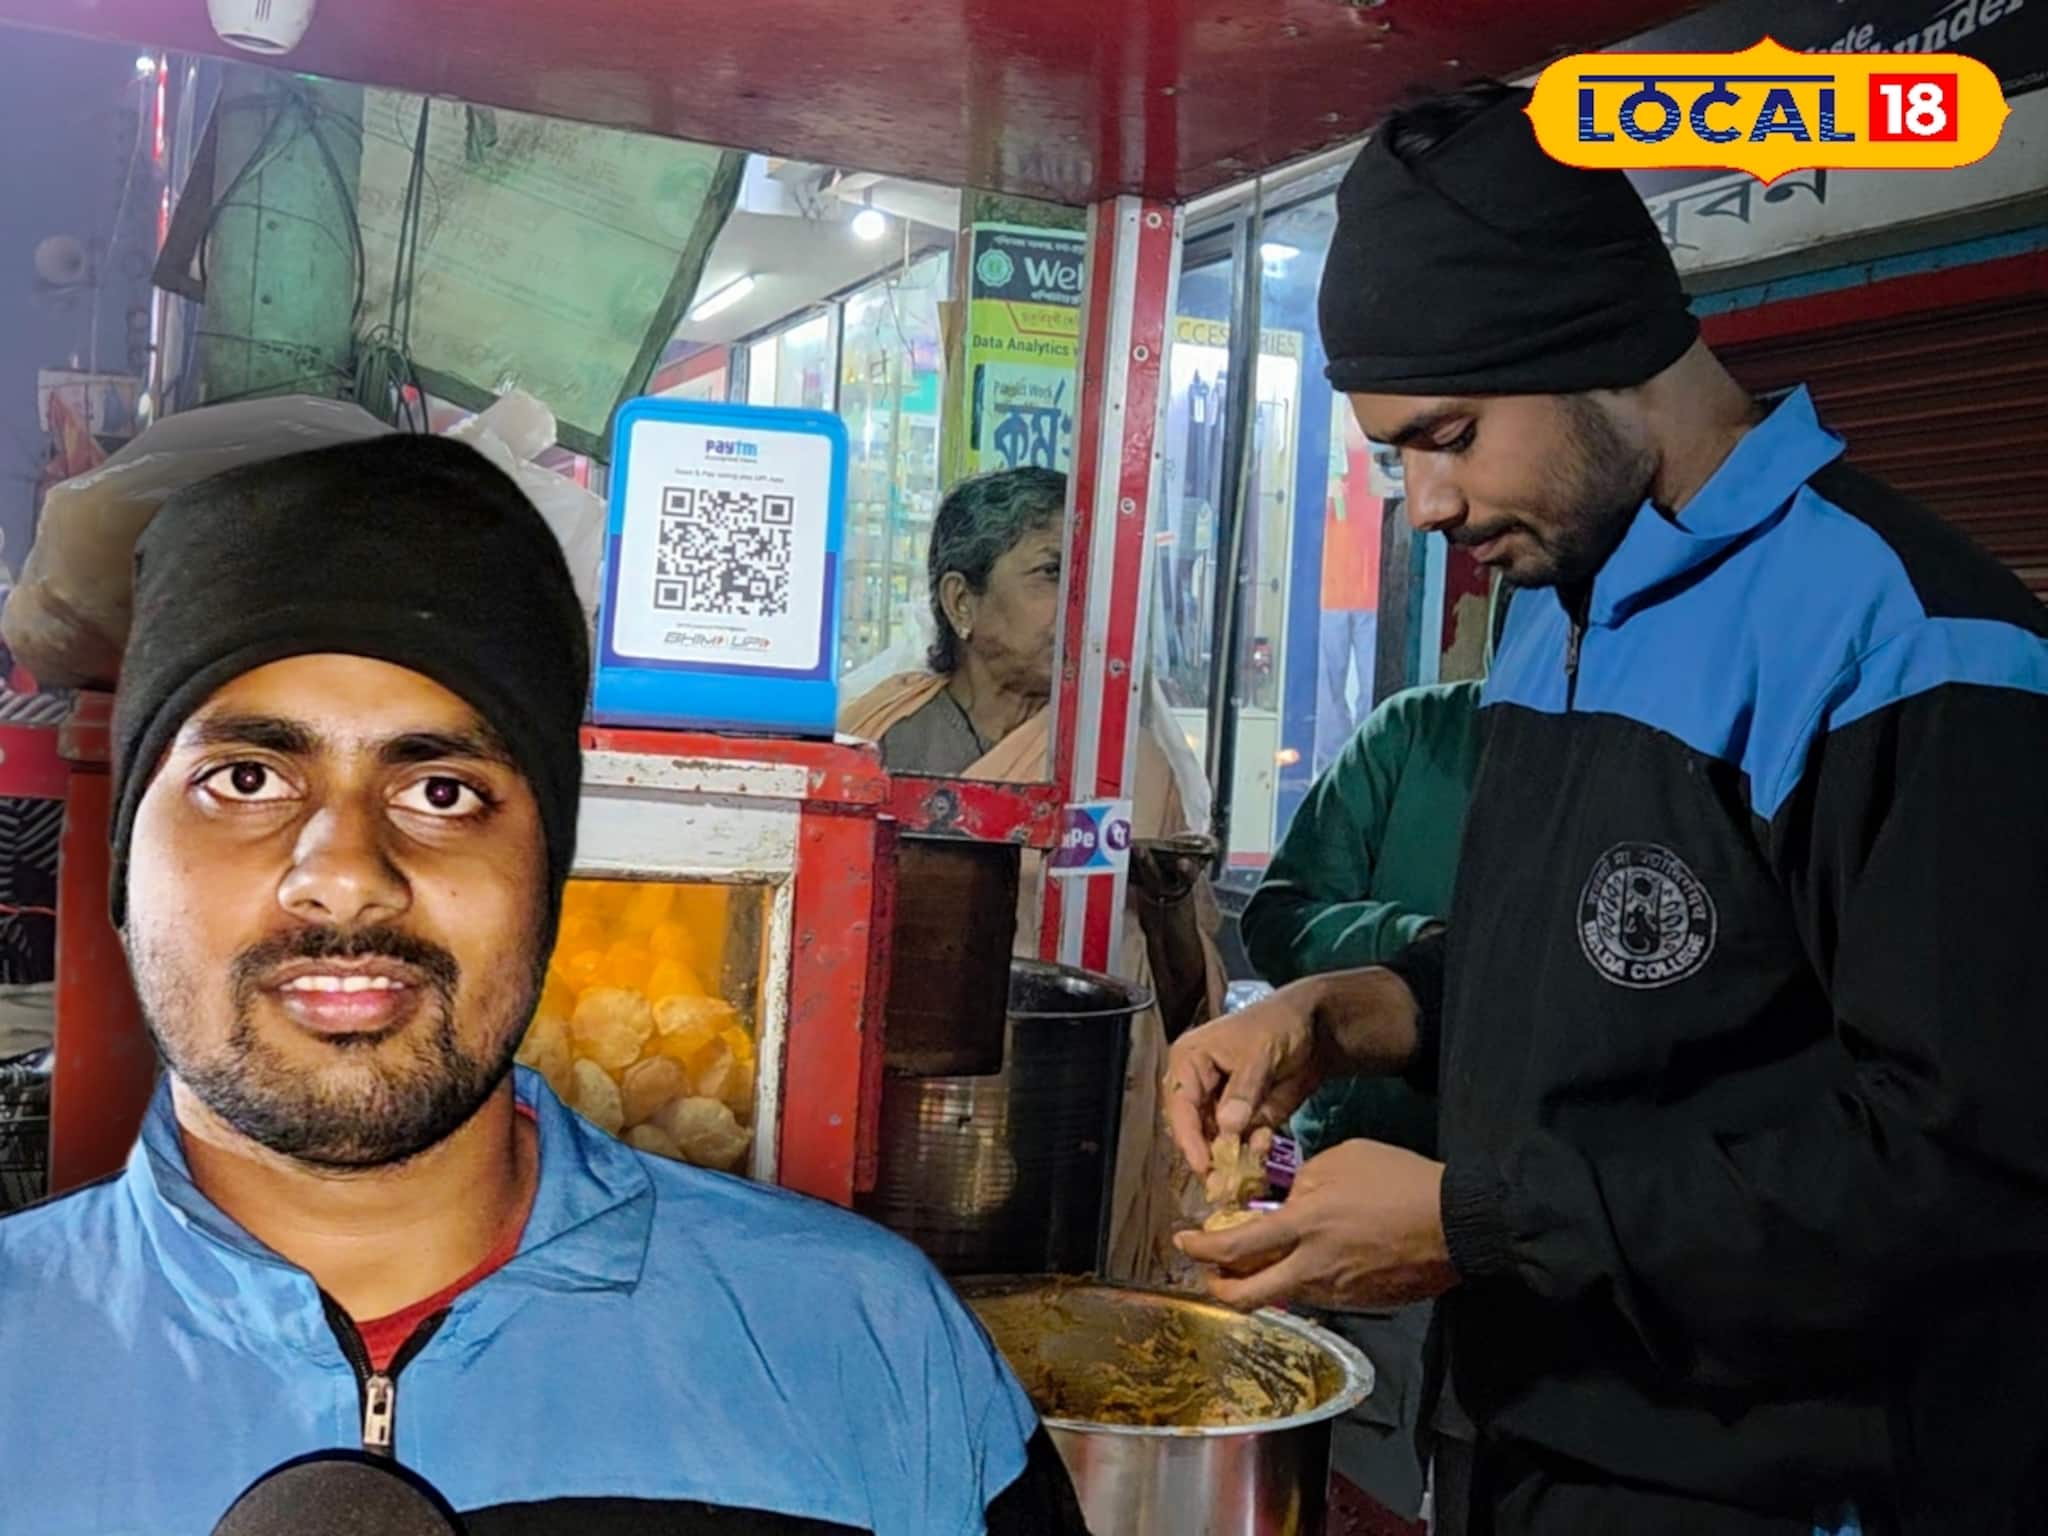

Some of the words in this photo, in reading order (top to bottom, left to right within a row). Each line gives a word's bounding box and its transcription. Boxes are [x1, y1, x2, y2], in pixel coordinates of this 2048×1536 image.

[973, 334, 1003, 350] Data
[1007, 336, 1069, 356] Analytics
[1630, 932, 1706, 981] COLLEGE
